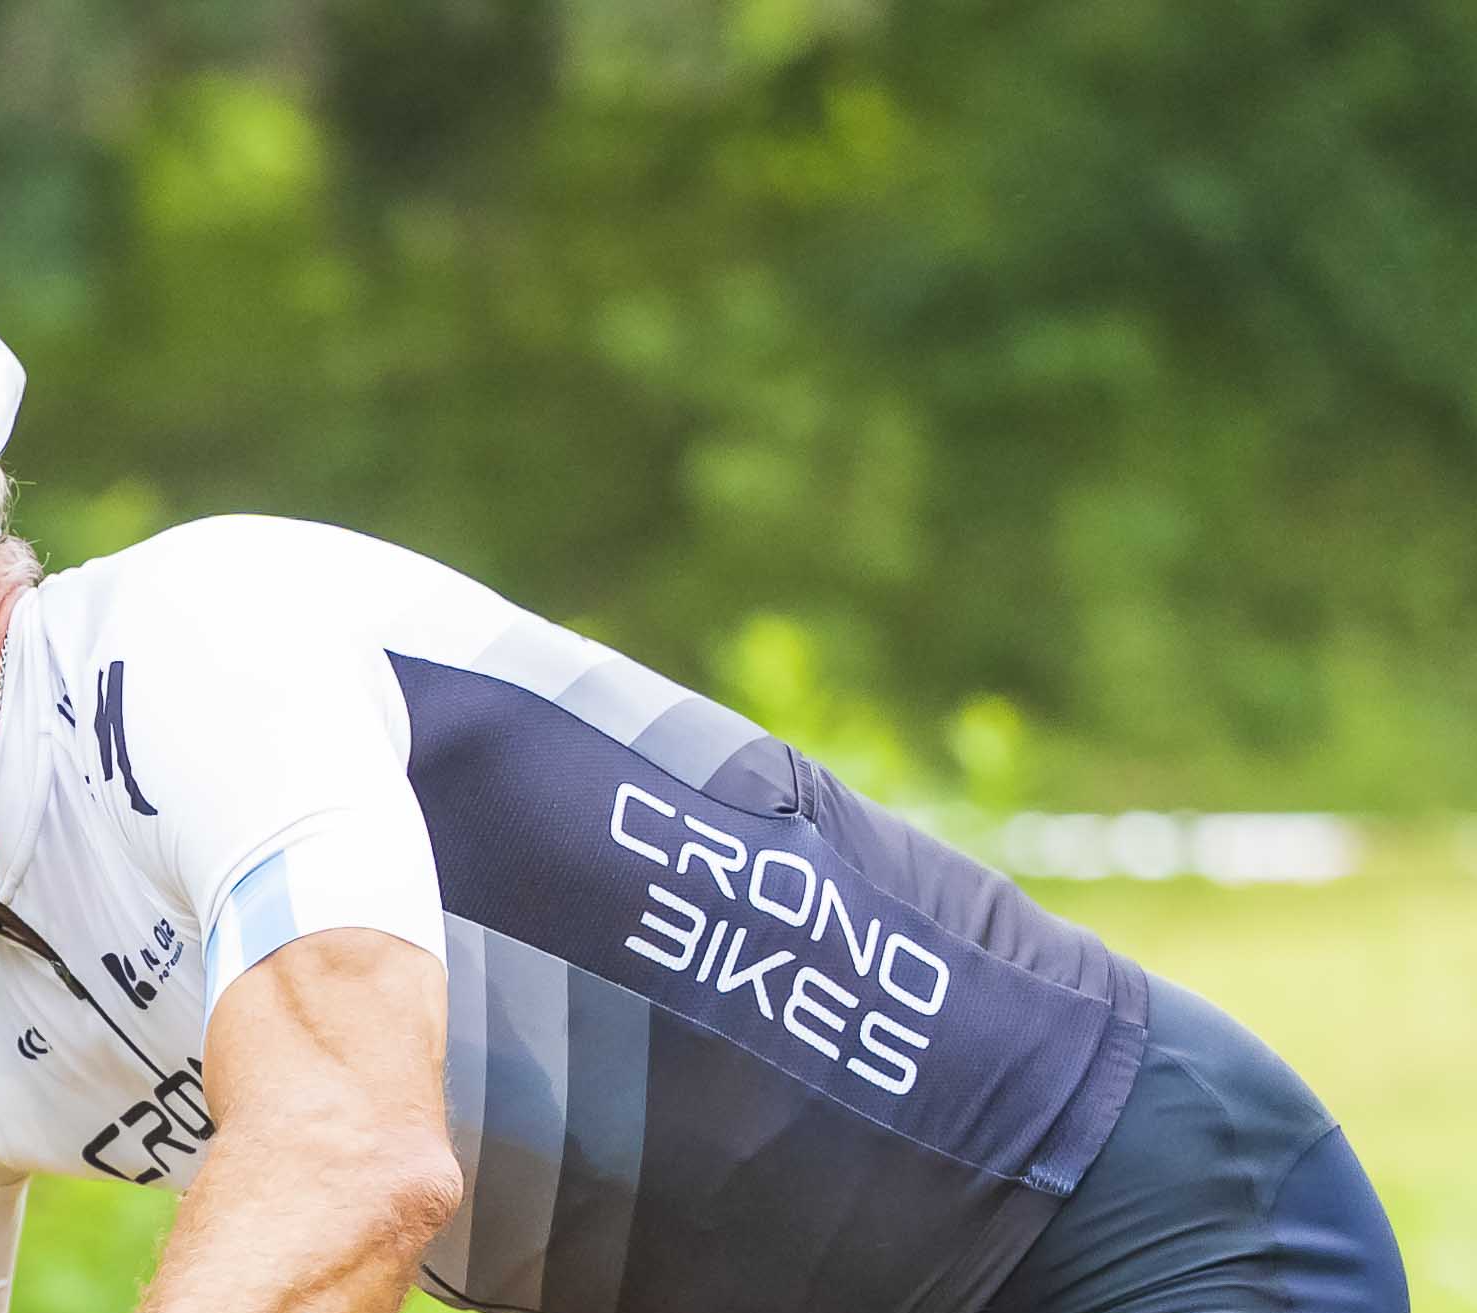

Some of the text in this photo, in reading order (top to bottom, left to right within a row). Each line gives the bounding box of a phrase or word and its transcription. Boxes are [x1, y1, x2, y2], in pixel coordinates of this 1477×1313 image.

[609, 781, 949, 1016] CRONO
[624, 883, 930, 1096] BIKES
[82, 1057, 218, 1184] CRO
